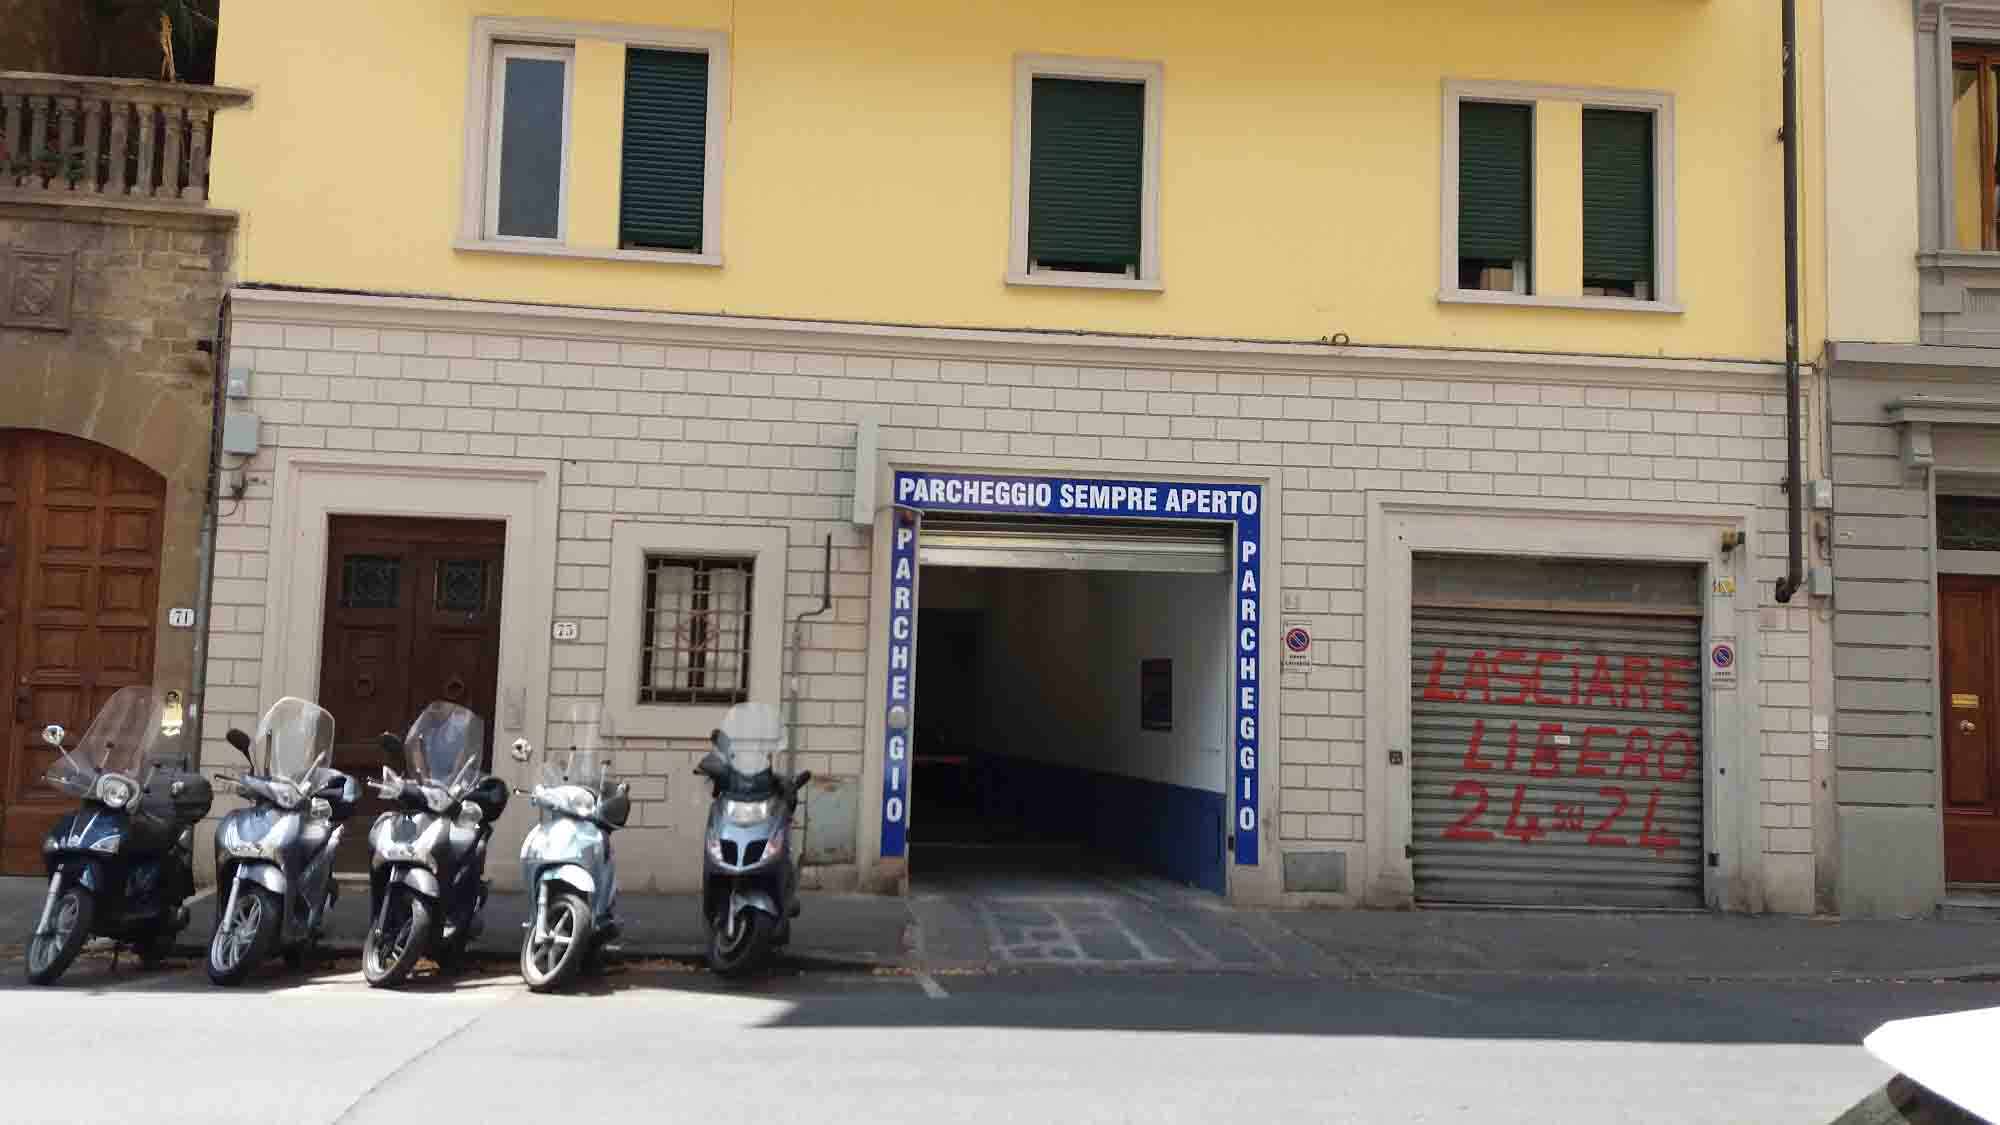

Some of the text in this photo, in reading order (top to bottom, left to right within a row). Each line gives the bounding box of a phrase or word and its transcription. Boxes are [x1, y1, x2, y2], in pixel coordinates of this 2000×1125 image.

[900, 478, 1257, 515] PARCHEGGIO SEMPRE APERTO
[887, 528, 912, 822] PARCHEGIO
[1240, 541, 1257, 830] PARCHEGGIO
[1441, 779, 1546, 844] 24
[1587, 786, 1681, 857] 24
